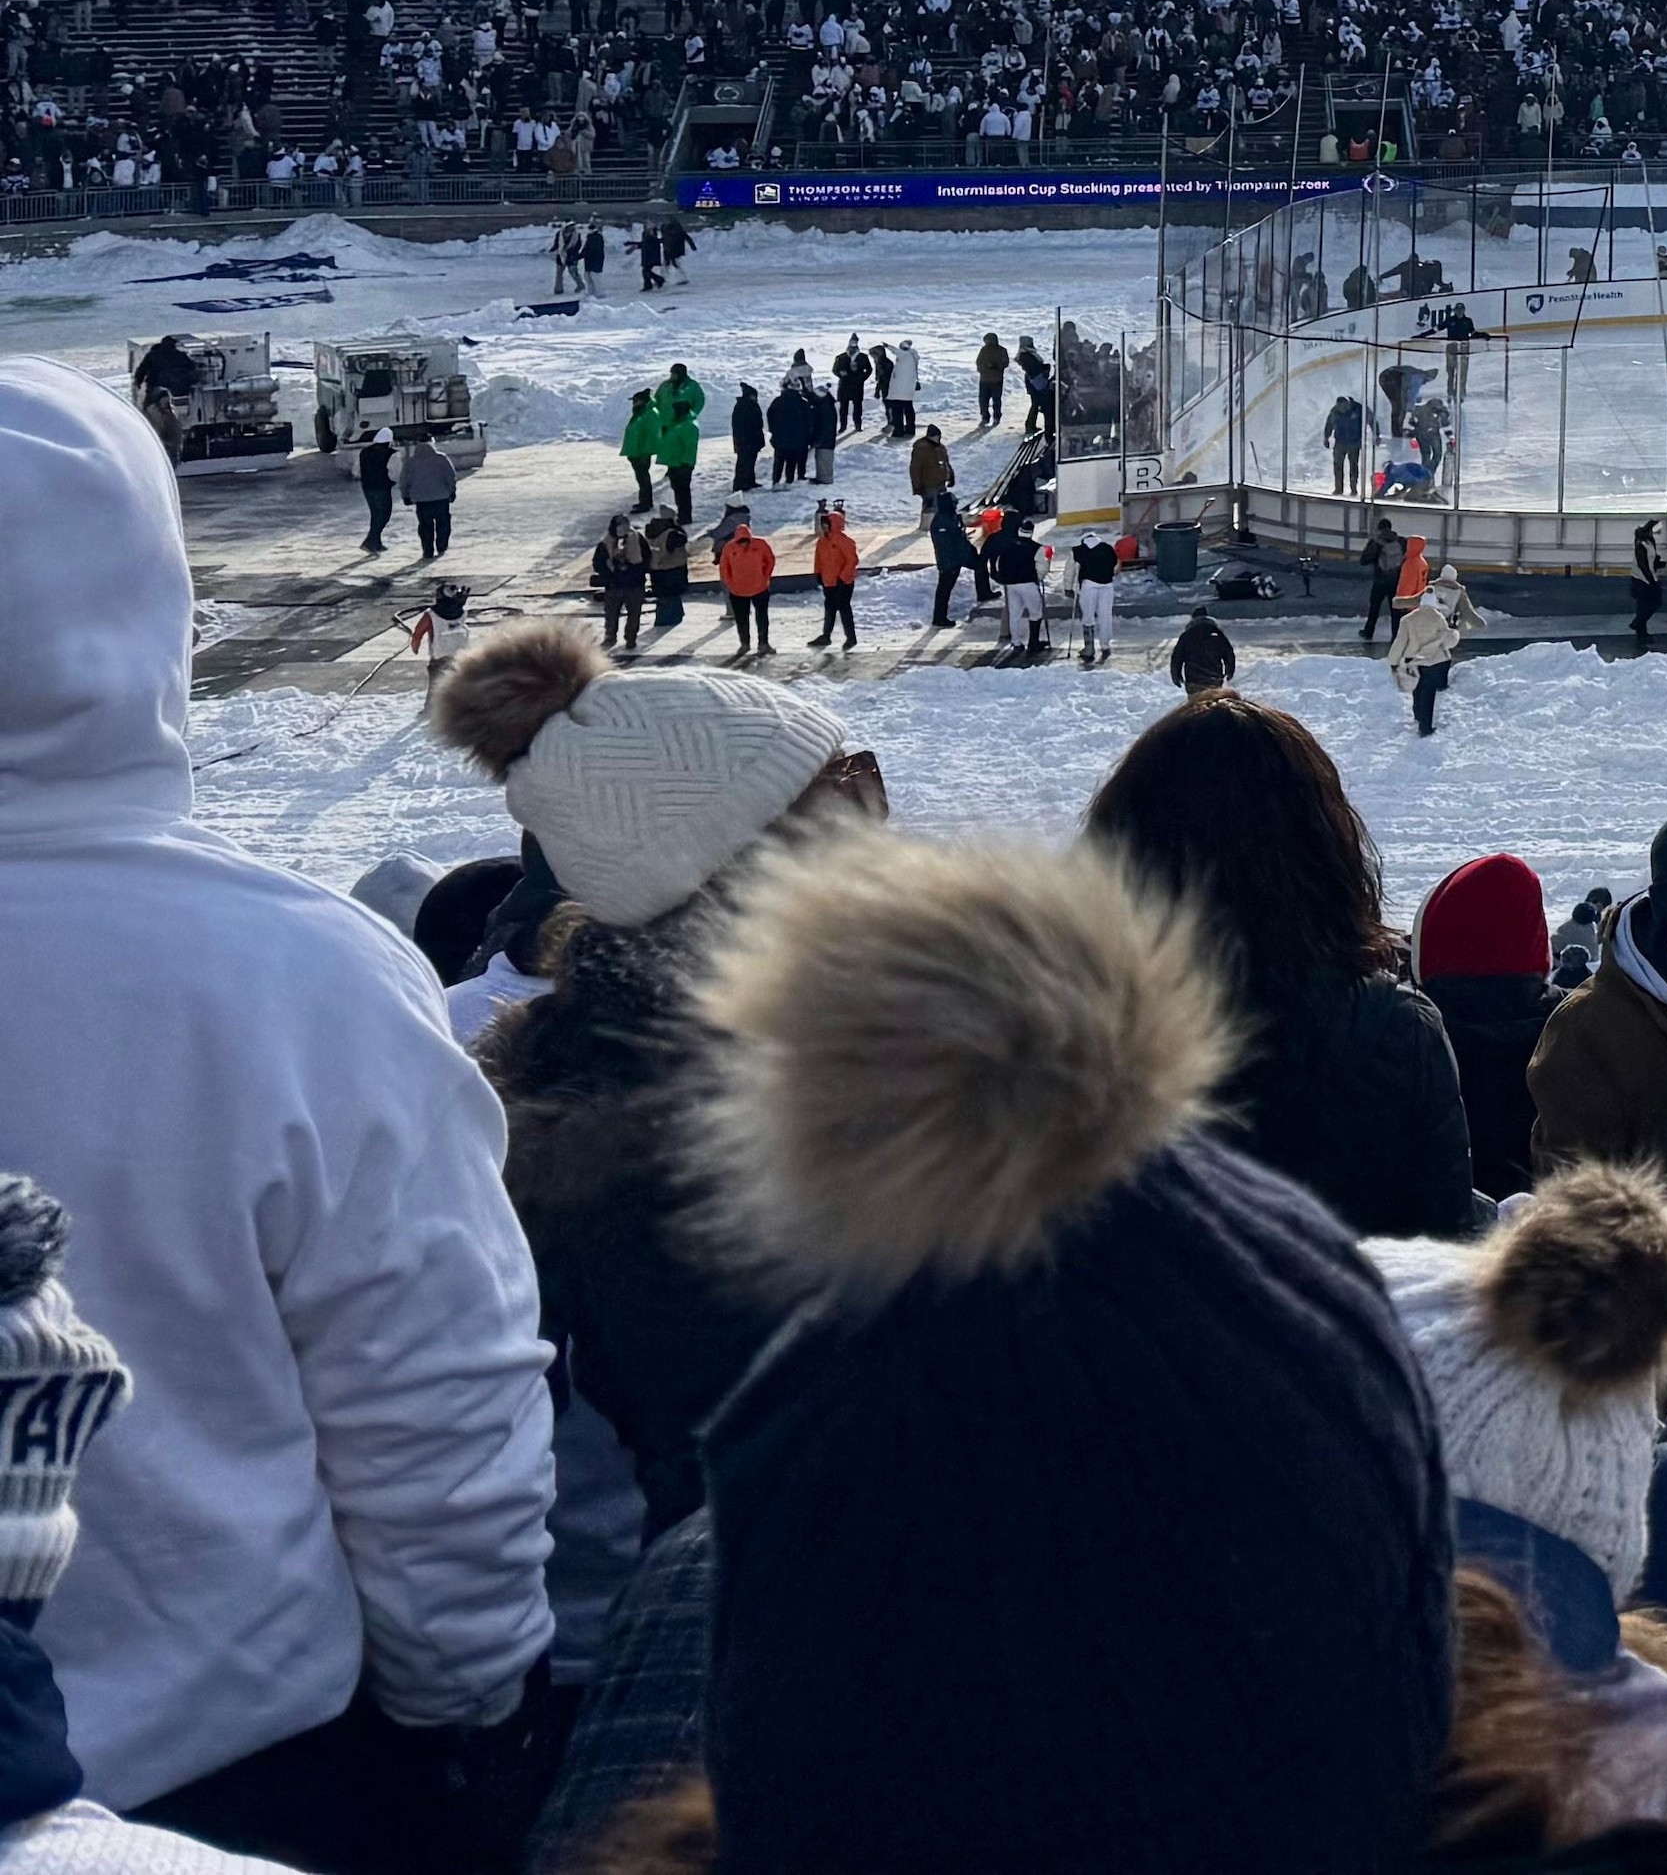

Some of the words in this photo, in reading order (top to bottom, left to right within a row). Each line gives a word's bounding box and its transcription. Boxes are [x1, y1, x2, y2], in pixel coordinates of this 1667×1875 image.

[789, 185, 860, 194] THOMPSON
[865, 185, 902, 193] CREEK
[938, 186, 1025, 197] Intermission
[1029, 184, 1057, 197] Cup
[1060, 183, 1120, 196] Stacking
[1123, 181, 1193, 194] preseted
[1196, 181, 1212, 193] by
